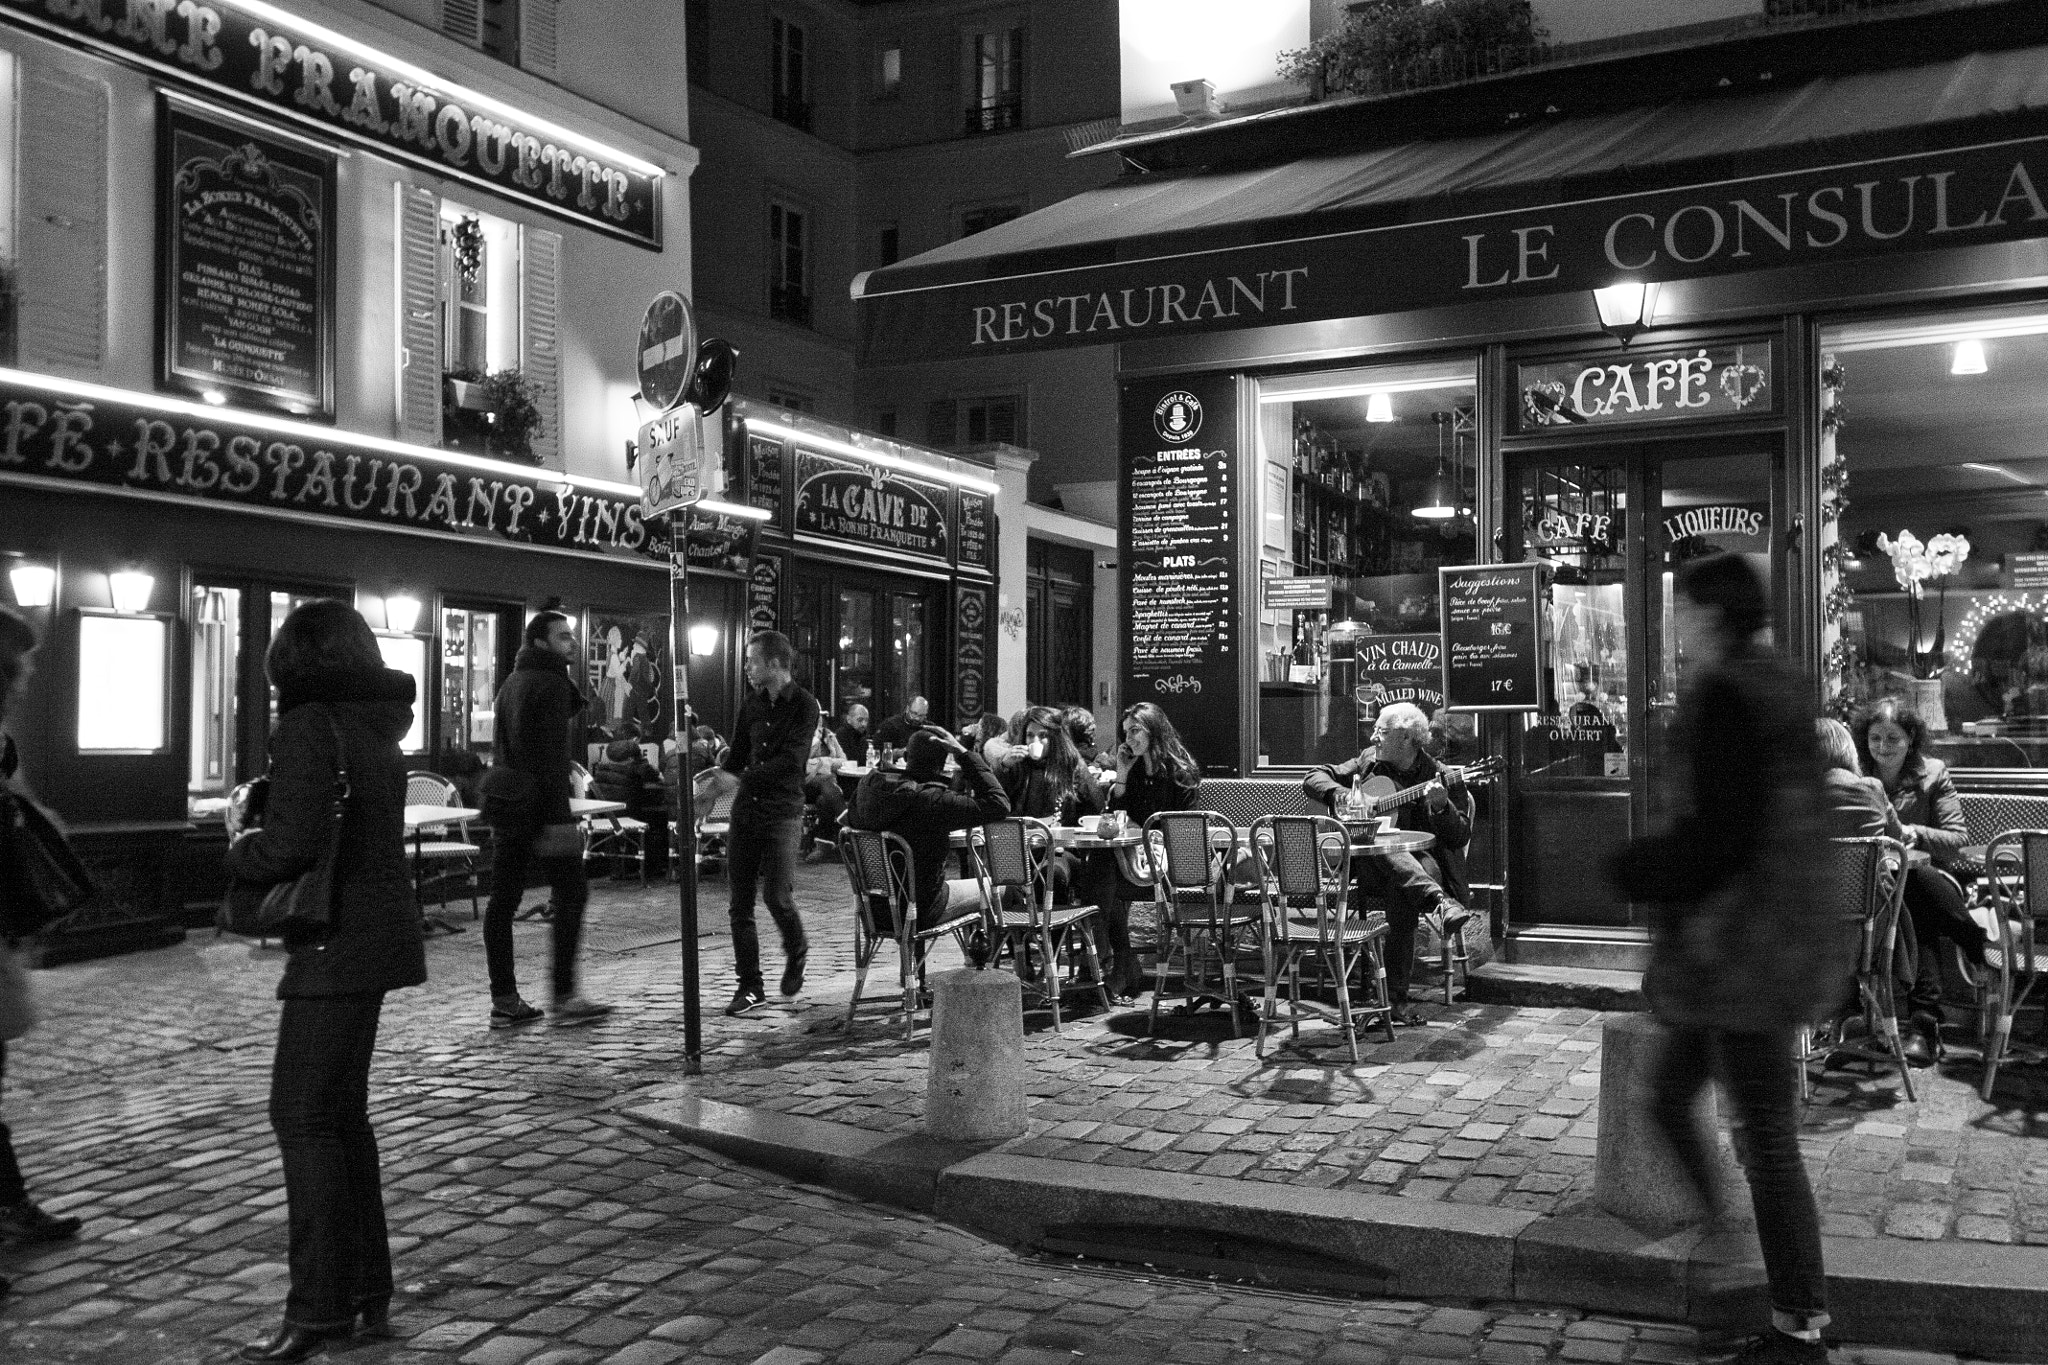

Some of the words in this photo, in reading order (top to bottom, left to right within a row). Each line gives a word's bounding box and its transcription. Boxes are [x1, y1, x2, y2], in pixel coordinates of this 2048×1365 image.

[249, 28, 630, 221] FRANQUETTE
[1462, 225, 1560, 289] LE
[971, 266, 1309, 345] RESTAURANT
[1570, 349, 1713, 416] CAFÉ
[1155, 394, 1178, 415] Bistrot
[1184, 395, 1200, 411] Café
[1157, 448, 1201, 462] ENTRÉES
[127, 416, 536, 535] RESTAURANT
[556, 478, 648, 552] VINS
[821, 483, 839, 510] LA
[842, 484, 905, 527] CAVE
[910, 503, 928, 528] DE
[820, 512, 836, 531] LA
[838, 517, 869, 537] BONNE
[869, 523, 928, 548] FRANQUETTE
[1663, 506, 1763, 543] LIQUEURS
[1163, 555, 1196, 568] PLATS
[1450, 576, 1520, 595] Suggestions
[1160, 621, 1170, 630] de
[1153, 634, 1162, 642] de
[1150, 646, 1159, 654] de
[1357, 643, 1387, 663] VIN
[1391, 640, 1439, 660] CHAUD
[1367, 660, 1377, 671] à
[1379, 658, 1390, 671] la
[1392, 657, 1434, 671] Cannelle
[1375, 687, 1416, 707] MULLED
[1418, 687, 1444, 706] WINE
[1535, 714, 1617, 727] RESTAURANT
[1549, 729, 1603, 741] OUVERT
